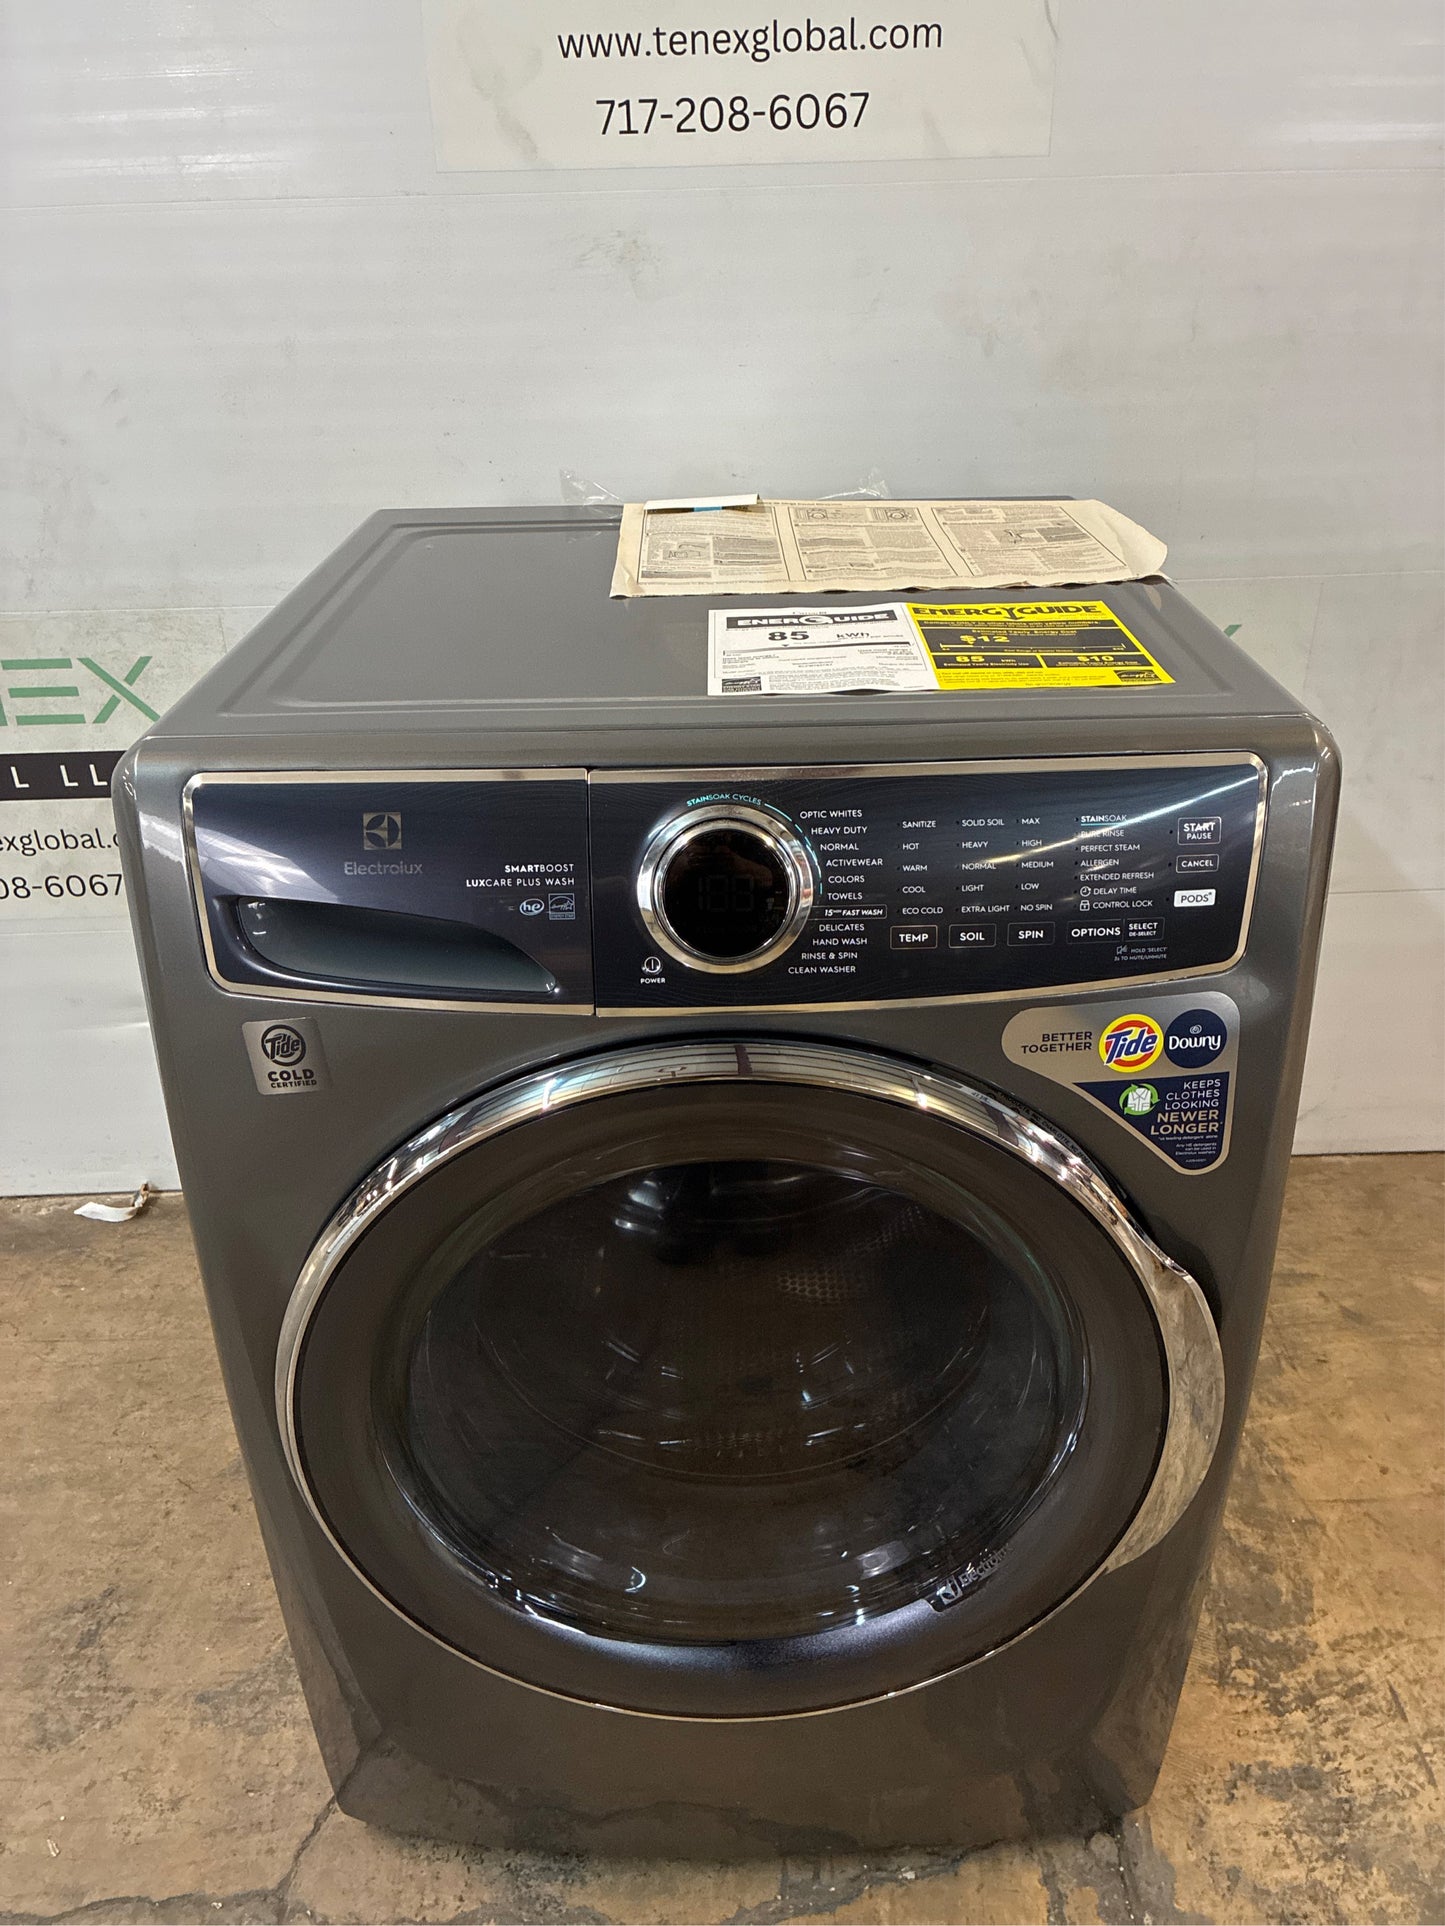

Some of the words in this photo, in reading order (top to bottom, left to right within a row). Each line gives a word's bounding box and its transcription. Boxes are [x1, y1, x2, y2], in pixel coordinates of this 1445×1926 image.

[557, 18, 943, 62] www.tenexglobal.com
[596, 92, 871, 135] 717-208-6067
[768, 631, 810, 641] 85
[960, 634, 1010, 644] $12
[0, 656, 160, 727] EX
[686, 794, 730, 806] STAINSOAK
[732, 794, 762, 806] CYCLES
[800, 810, 826, 820] OPTIC
[830, 809, 862, 818] WHITES
[1080, 814, 1127, 822] STAINSOAK
[902, 820, 936, 828] SANITIZE
[962, 819, 986, 827] SOLID
[1183, 822, 1216, 832] START
[811, 826, 841, 835] HEAVY
[844, 826, 868, 834] DUTY
[820, 842, 859, 851] NORMAL
[962, 841, 988, 849] HEAVY
[1080, 844, 1113, 852] PERFECT
[826, 858, 884, 867] ACTIVEWEAR
[962, 862, 996, 870] NORMAL
[1080, 858, 1120, 867] ALLERGEN
[1182, 860, 1214, 868] CANCEL
[344, 860, 423, 876] Electrolux
[504, 864, 574, 873] SMARTBOOST
[828, 875, 865, 884] COLORS
[1080, 873, 1120, 881] EXTENDED
[1122, 872, 1154, 880] REFRESH
[466, 878, 513, 888] LUXCARE
[516, 878, 541, 887] PLUS
[545, 877, 575, 886] WASH
[902, 886, 926, 894] COOL
[962, 884, 984, 892] LIGHT
[1094, 888, 1118, 896] DELAY
[827, 892, 863, 900] TOWELS
[962, 905, 986, 913] EXTRA
[988, 904, 1010, 912] LIGHT
[1092, 901, 1130, 910] CONTROL
[1132, 900, 1153, 908] LOCK
[902, 907, 919, 915] ECO
[920, 906, 944, 914] COLD
[819, 924, 865, 932] DELICATES
[1128, 922, 1158, 930] SELECT
[1018, 930, 1044, 939] SPIN
[1072, 926, 1121, 936] OPTIONS
[899, 934, 929, 942] TEMP
[960, 932, 986, 941] SOIL
[812, 938, 838, 946] HAND
[841, 937, 868, 946] WASH
[802, 952, 826, 960] RINSE
[828, 952, 836, 960] &
[838, 952, 858, 960] SPIN
[788, 966, 817, 974] CLEAN
[820, 965, 856, 974] WASHER
[1042, 1031, 1092, 1042] BETTER
[265, 1032, 300, 1060] Tide
[1168, 1033, 1222, 1050] Downy
[1021, 1042, 1092, 1054] TOGETHER
[1104, 1027, 1158, 1066] Tide
[267, 1068, 314, 1082] COLD
[270, 1080, 318, 1088] CERTIFIED
[1183, 1078, 1221, 1090] KEEPS
[1166, 1089, 1220, 1100] CLOTHES
[1165, 1099, 1220, 1110] LOOKING
[1156, 1110, 1220, 1123] NEWER
